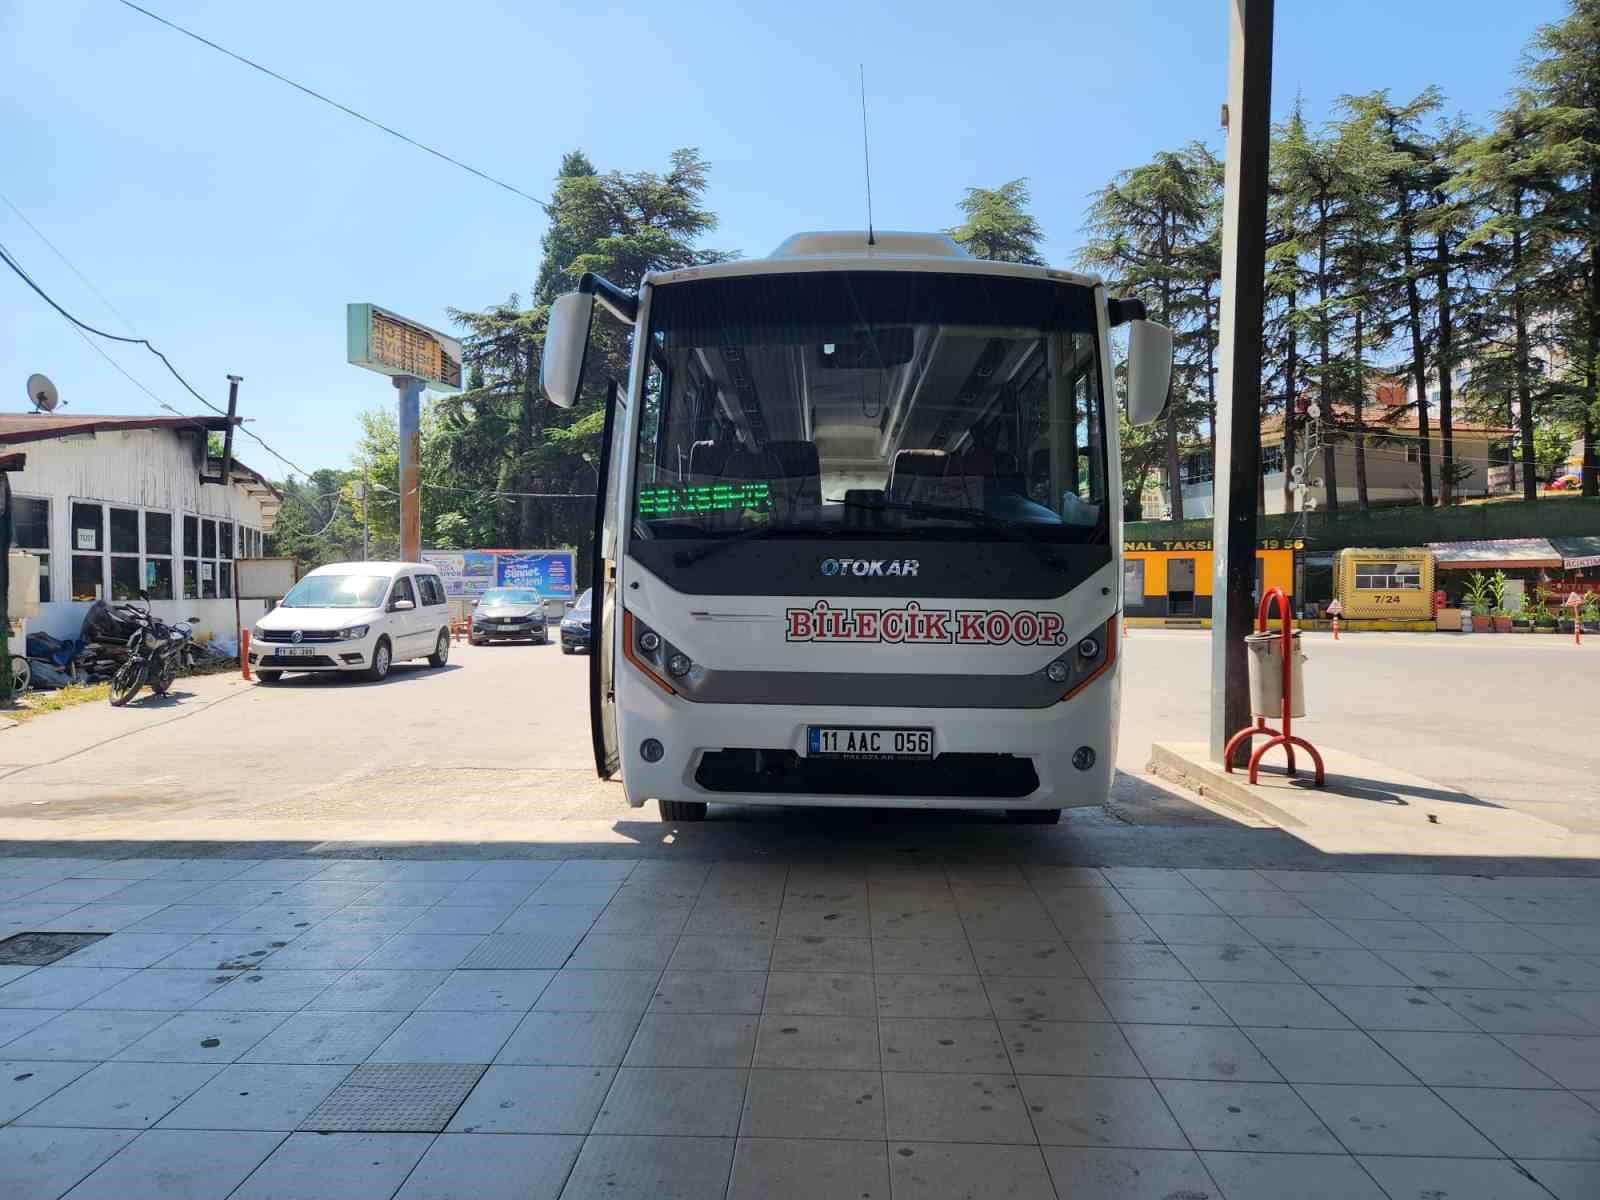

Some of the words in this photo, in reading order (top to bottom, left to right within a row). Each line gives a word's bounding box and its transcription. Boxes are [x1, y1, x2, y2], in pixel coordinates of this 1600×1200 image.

[821, 559, 919, 576] OTOKAR
[1374, 595, 1401, 603] 7/24
[786, 600, 952, 643] BİLECİK
[956, 610, 1068, 646] KOOP.
[823, 732, 837, 751] 11
[847, 732, 881, 751] AAC
[894, 733, 929, 752] 056
